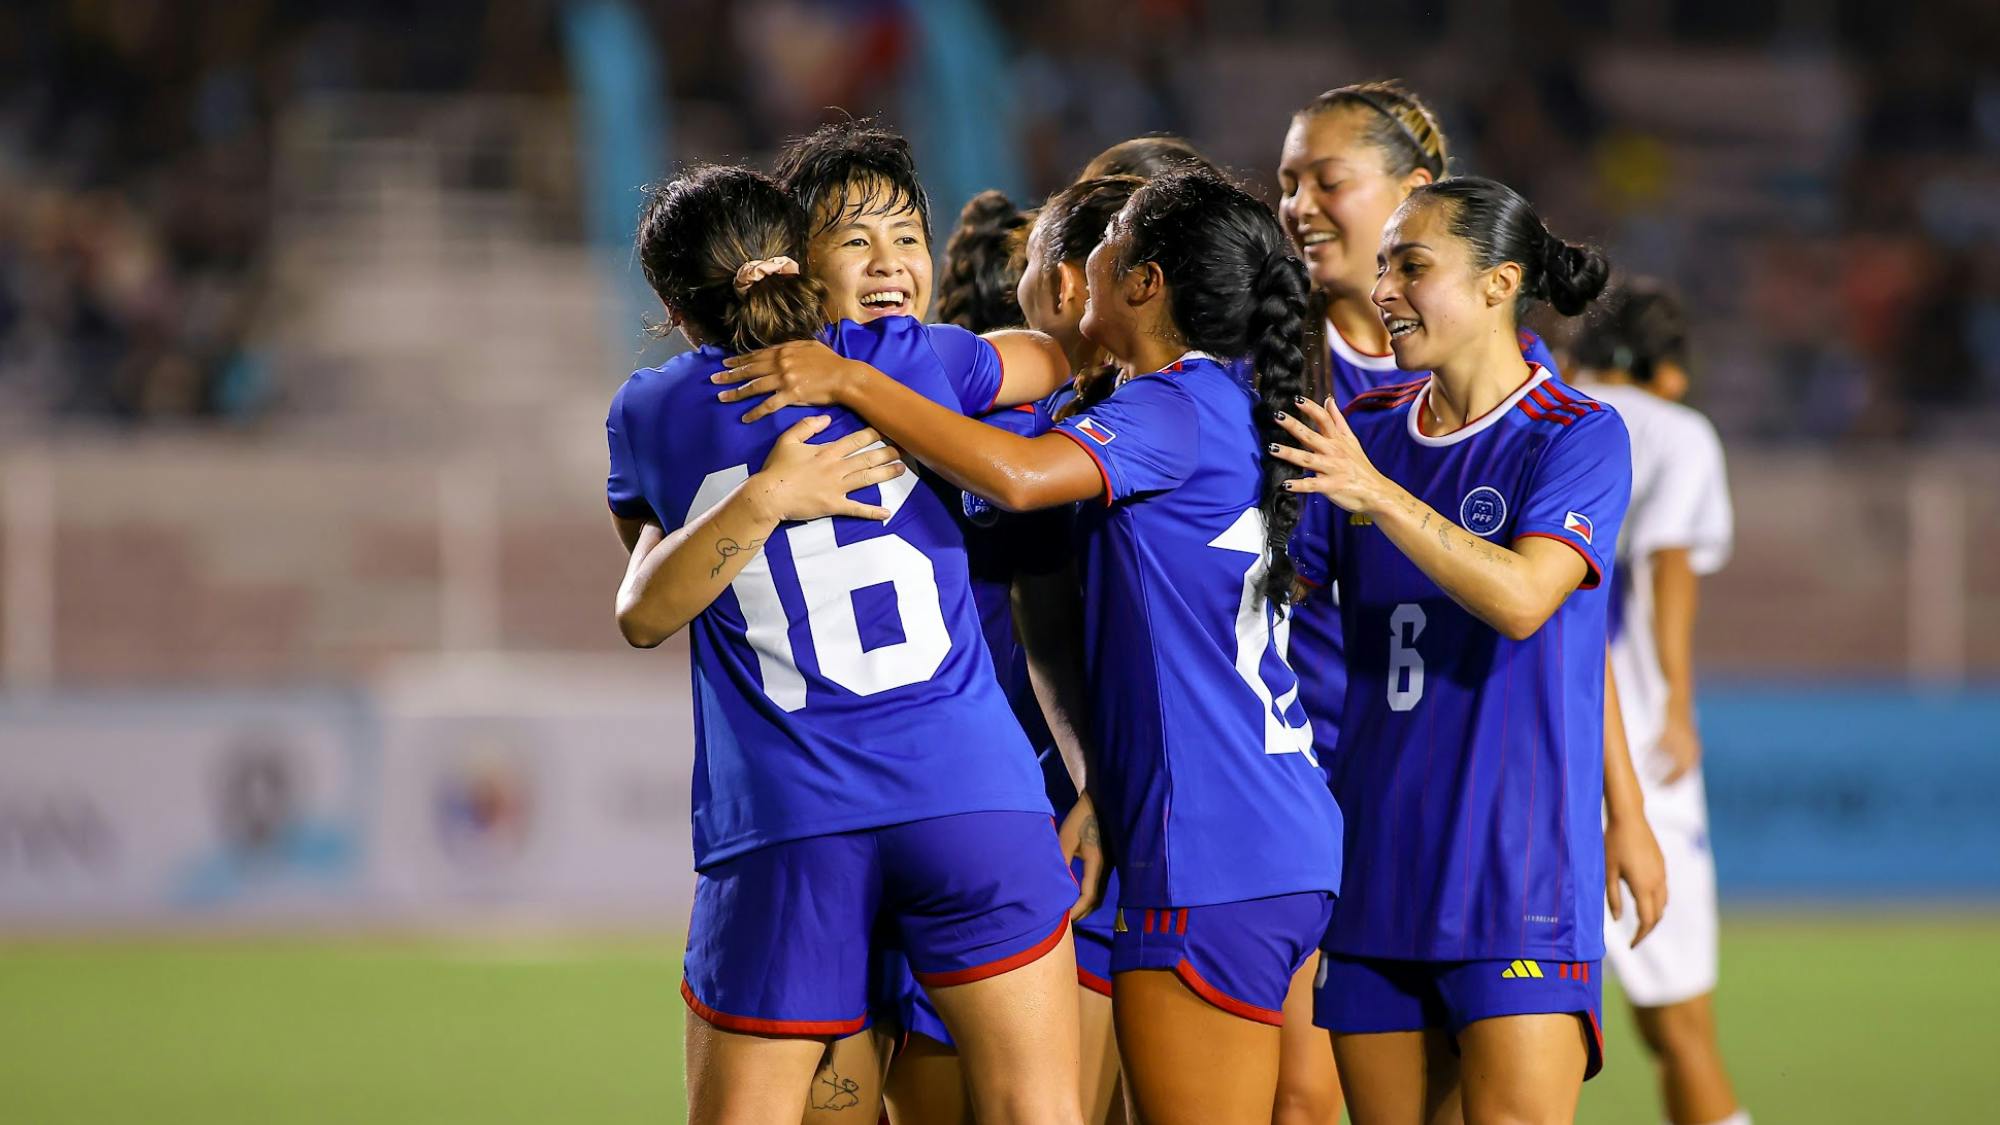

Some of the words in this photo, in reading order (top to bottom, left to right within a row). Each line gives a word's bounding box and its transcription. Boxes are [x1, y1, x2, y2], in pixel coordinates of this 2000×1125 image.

[1472, 512, 1493, 523] PFF
[683, 440, 952, 713] 16
[1387, 603, 1427, 712] 6
